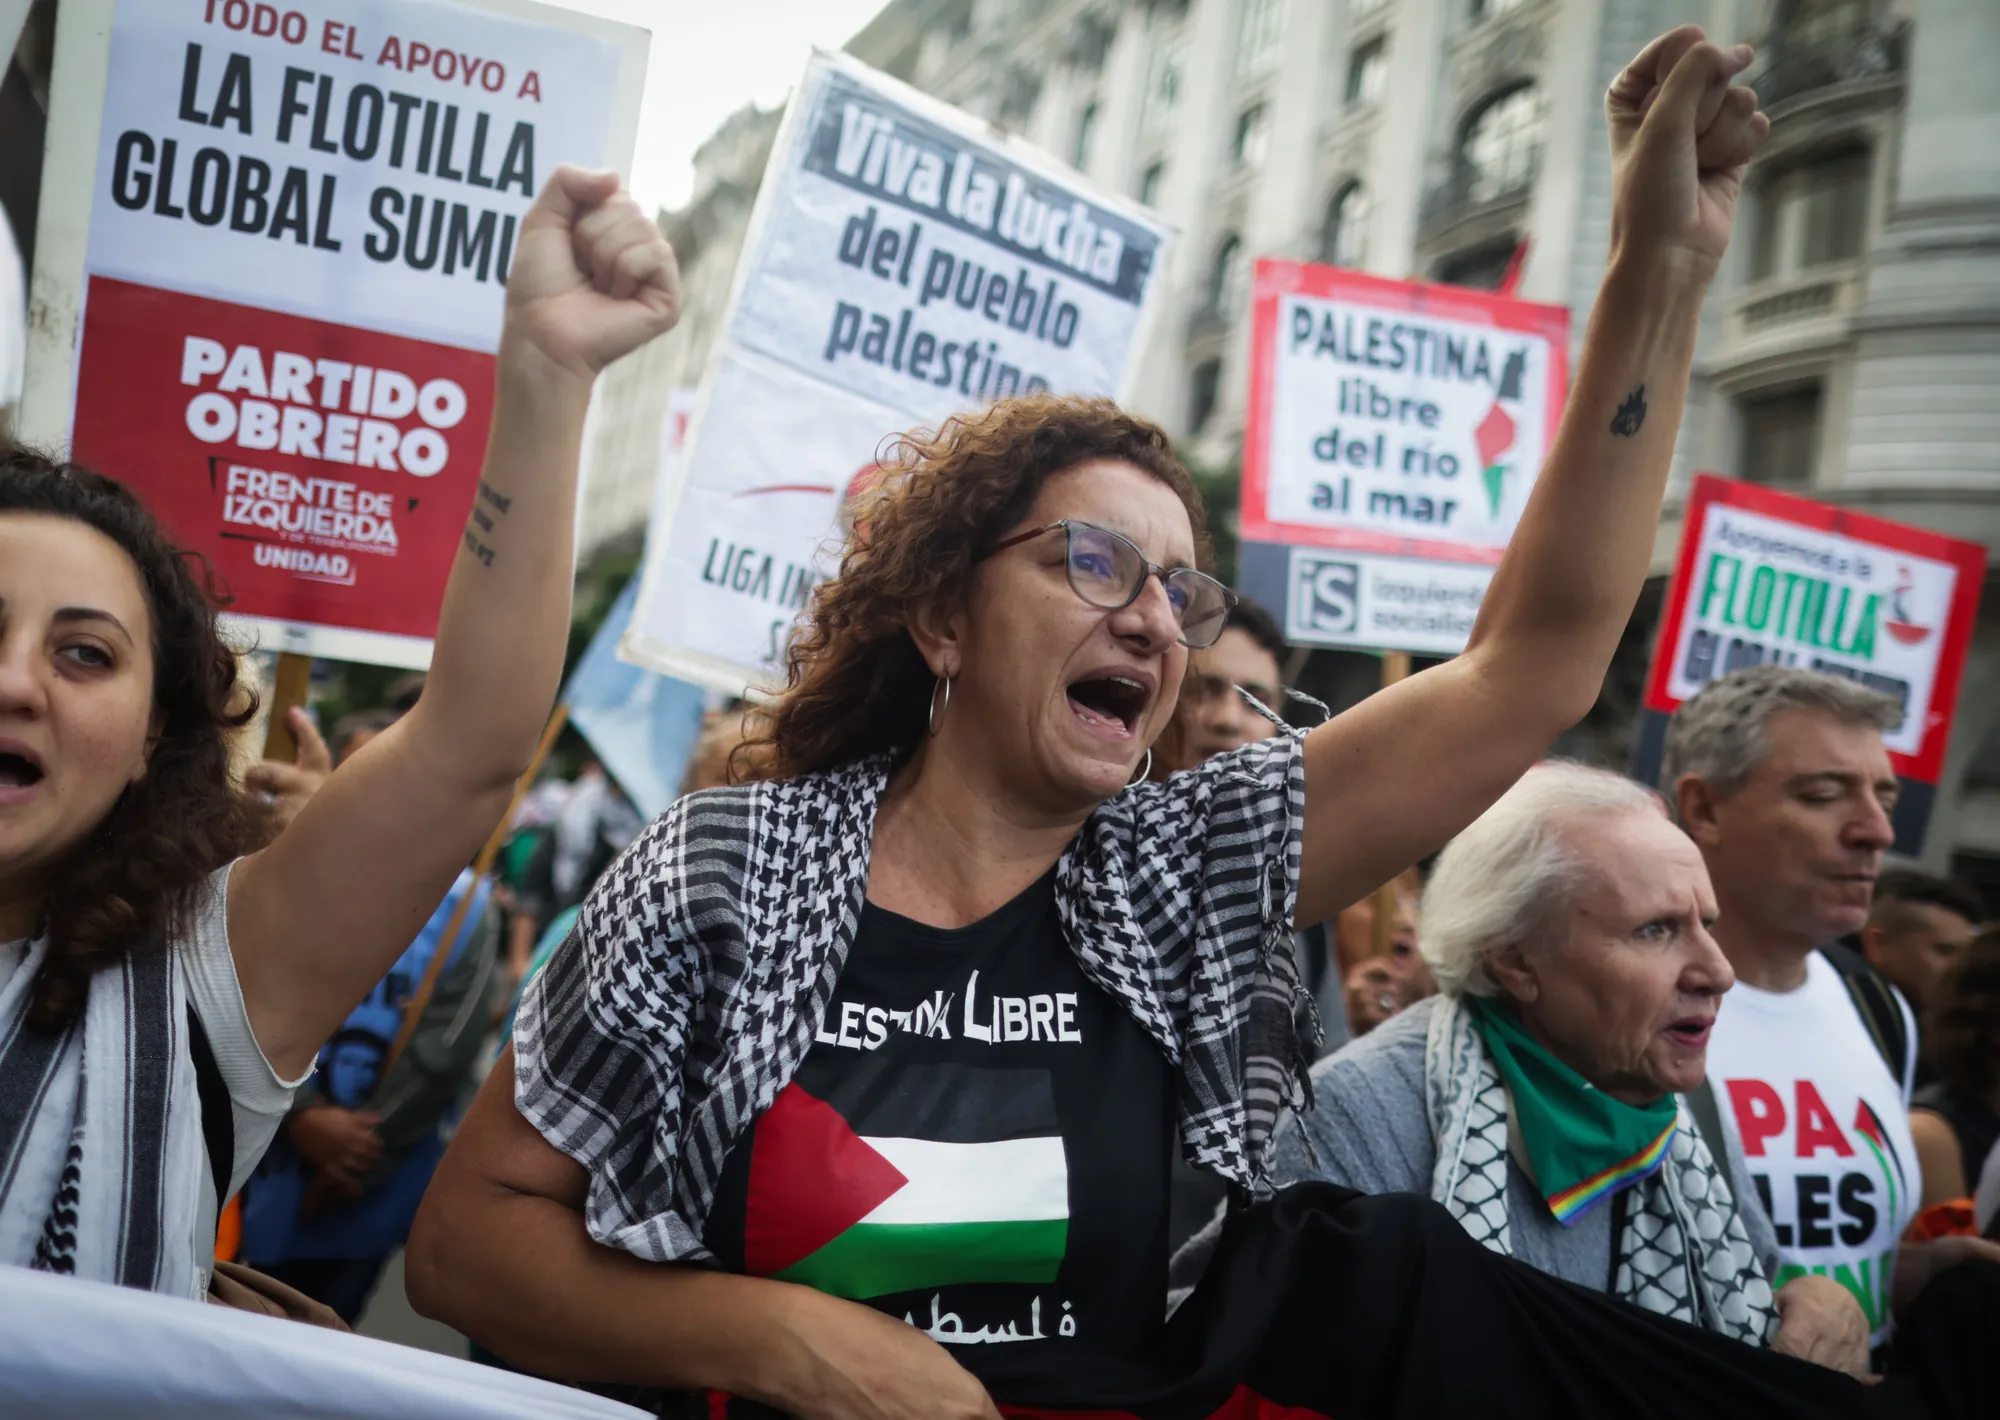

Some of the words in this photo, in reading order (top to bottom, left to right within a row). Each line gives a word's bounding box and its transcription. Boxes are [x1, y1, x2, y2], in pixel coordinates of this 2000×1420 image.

[204, 0, 307, 45] TODO
[321, 20, 364, 61] EL
[377, 35, 505, 92] APOYO
[517, 70, 542, 103] A
[178, 43, 253, 136] LA
[275, 66, 535, 198] FLOTILLA
[111, 130, 342, 253] GLOBAL
[835, 103, 945, 214] Viva
[946, 151, 998, 233] la
[998, 169, 1126, 286] lucha
[838, 205, 922, 288] del
[919, 248, 1081, 350] pueblo
[180, 336, 467, 430] PARTIDO
[1292, 305, 1494, 385] PALESTINA
[185, 393, 449, 477] OBRERO
[1337, 377, 1441, 428] libre
[1312, 428, 1384, 467] del
[223, 494, 399, 547] IZQUIERDA
[226, 465, 356, 511] FRENTE
[357, 491, 394, 517] DE
[1310, 477, 1352, 512] al
[1368, 490, 1459, 526] mar
[253, 543, 350, 578] UNIDAD
[702, 538, 773, 600] LIGA
[1699, 553, 1878, 660] FLOTILLA
[963, 969, 1082, 1046] LIBRE
[1724, 1078, 1856, 1158] PA
[1752, 1171, 1877, 1249] LES
